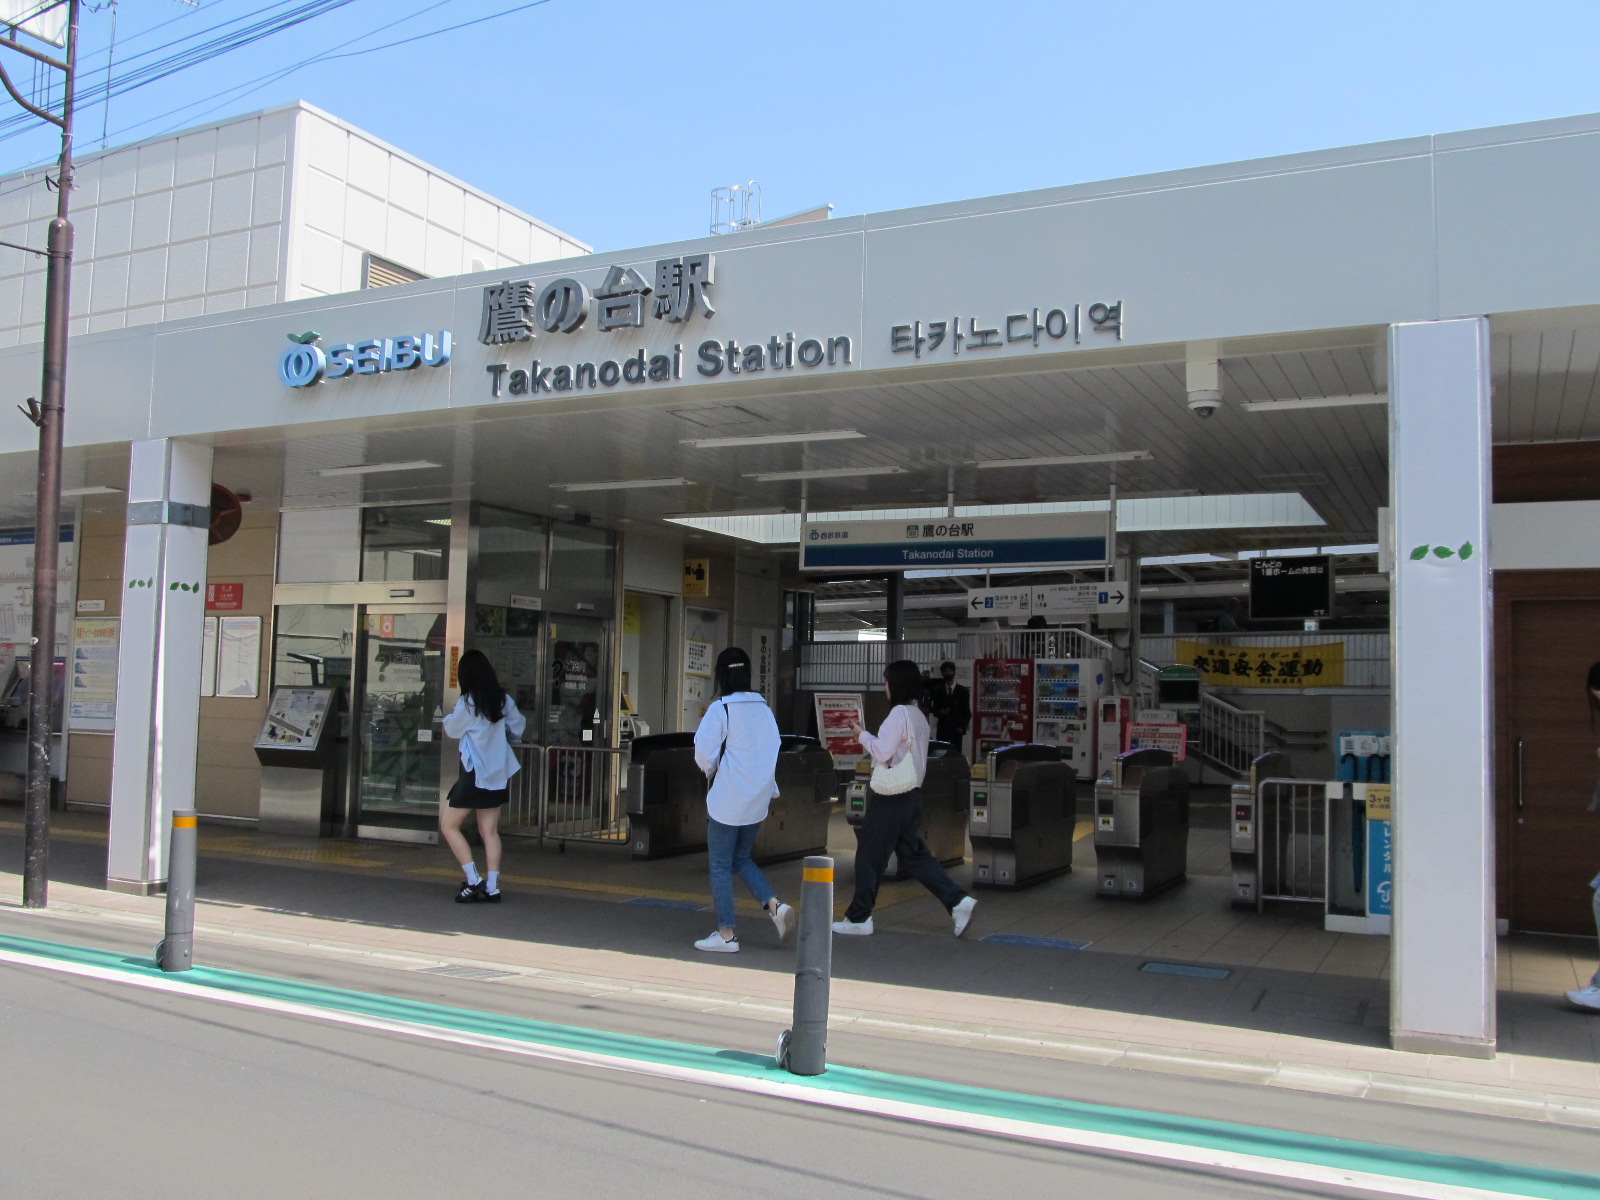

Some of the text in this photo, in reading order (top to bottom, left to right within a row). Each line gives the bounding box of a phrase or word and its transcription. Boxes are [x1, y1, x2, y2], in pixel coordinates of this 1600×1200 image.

[477, 253, 715, 346] 鷹の台駅
[891, 299, 1125, 358] 타카노다이역
[326, 330, 452, 380] SEIBU
[486, 331, 852, 397] Takanodai Station
[922, 523, 975, 538] 鷹の台駅
[902, 547, 994, 561] Takanodai Station
[1255, 561, 1283, 569] こんどの
[1193, 655, 1325, 678] 交通安全運動
